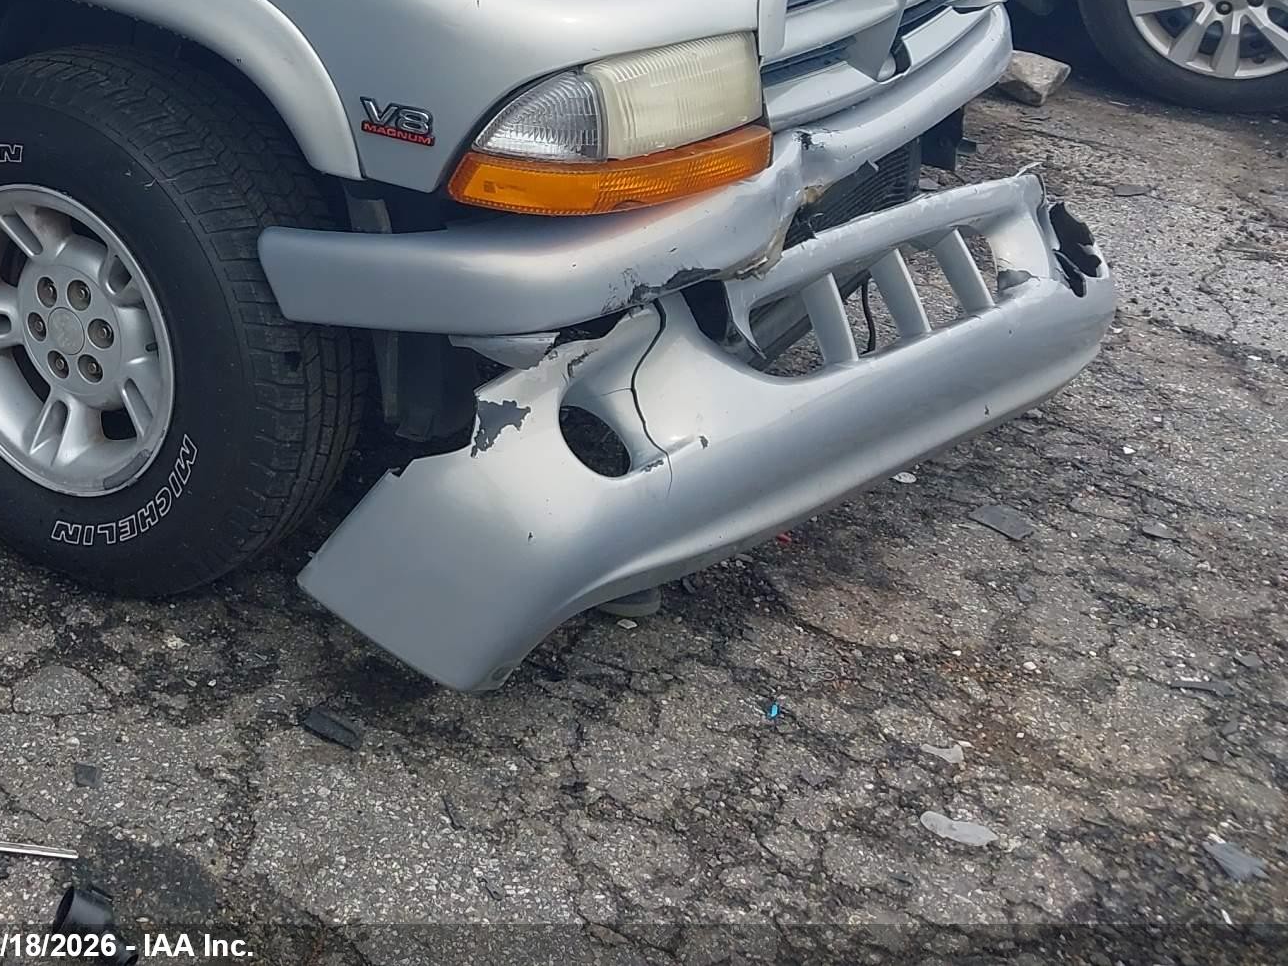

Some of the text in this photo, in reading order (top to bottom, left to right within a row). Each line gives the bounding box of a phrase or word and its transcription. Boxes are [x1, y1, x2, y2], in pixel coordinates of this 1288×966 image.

[360, 96, 433, 135] V8
[363, 122, 432, 145] MAGNUM
[51, 433, 198, 546] MICHELIN
